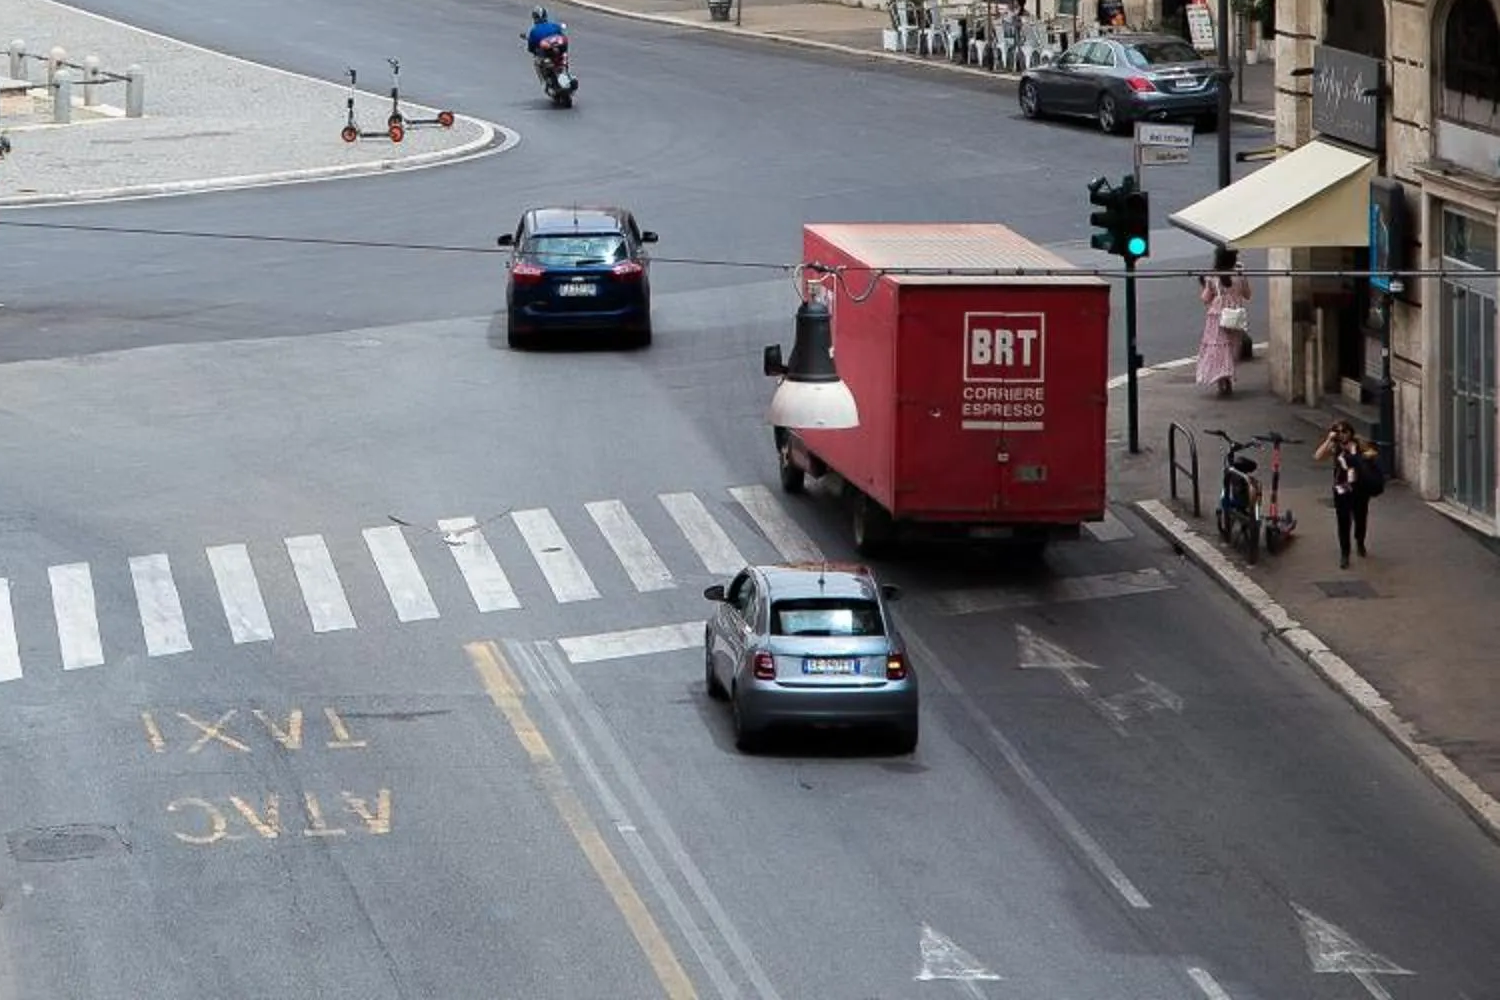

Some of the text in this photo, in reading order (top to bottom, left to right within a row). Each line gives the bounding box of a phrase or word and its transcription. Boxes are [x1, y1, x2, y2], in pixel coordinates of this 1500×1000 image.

[971, 328, 1037, 367] BRT
[963, 387, 1045, 401] CORRIERE
[962, 403, 1045, 417] ESPRESSO
[141, 707, 368, 754] TAXI
